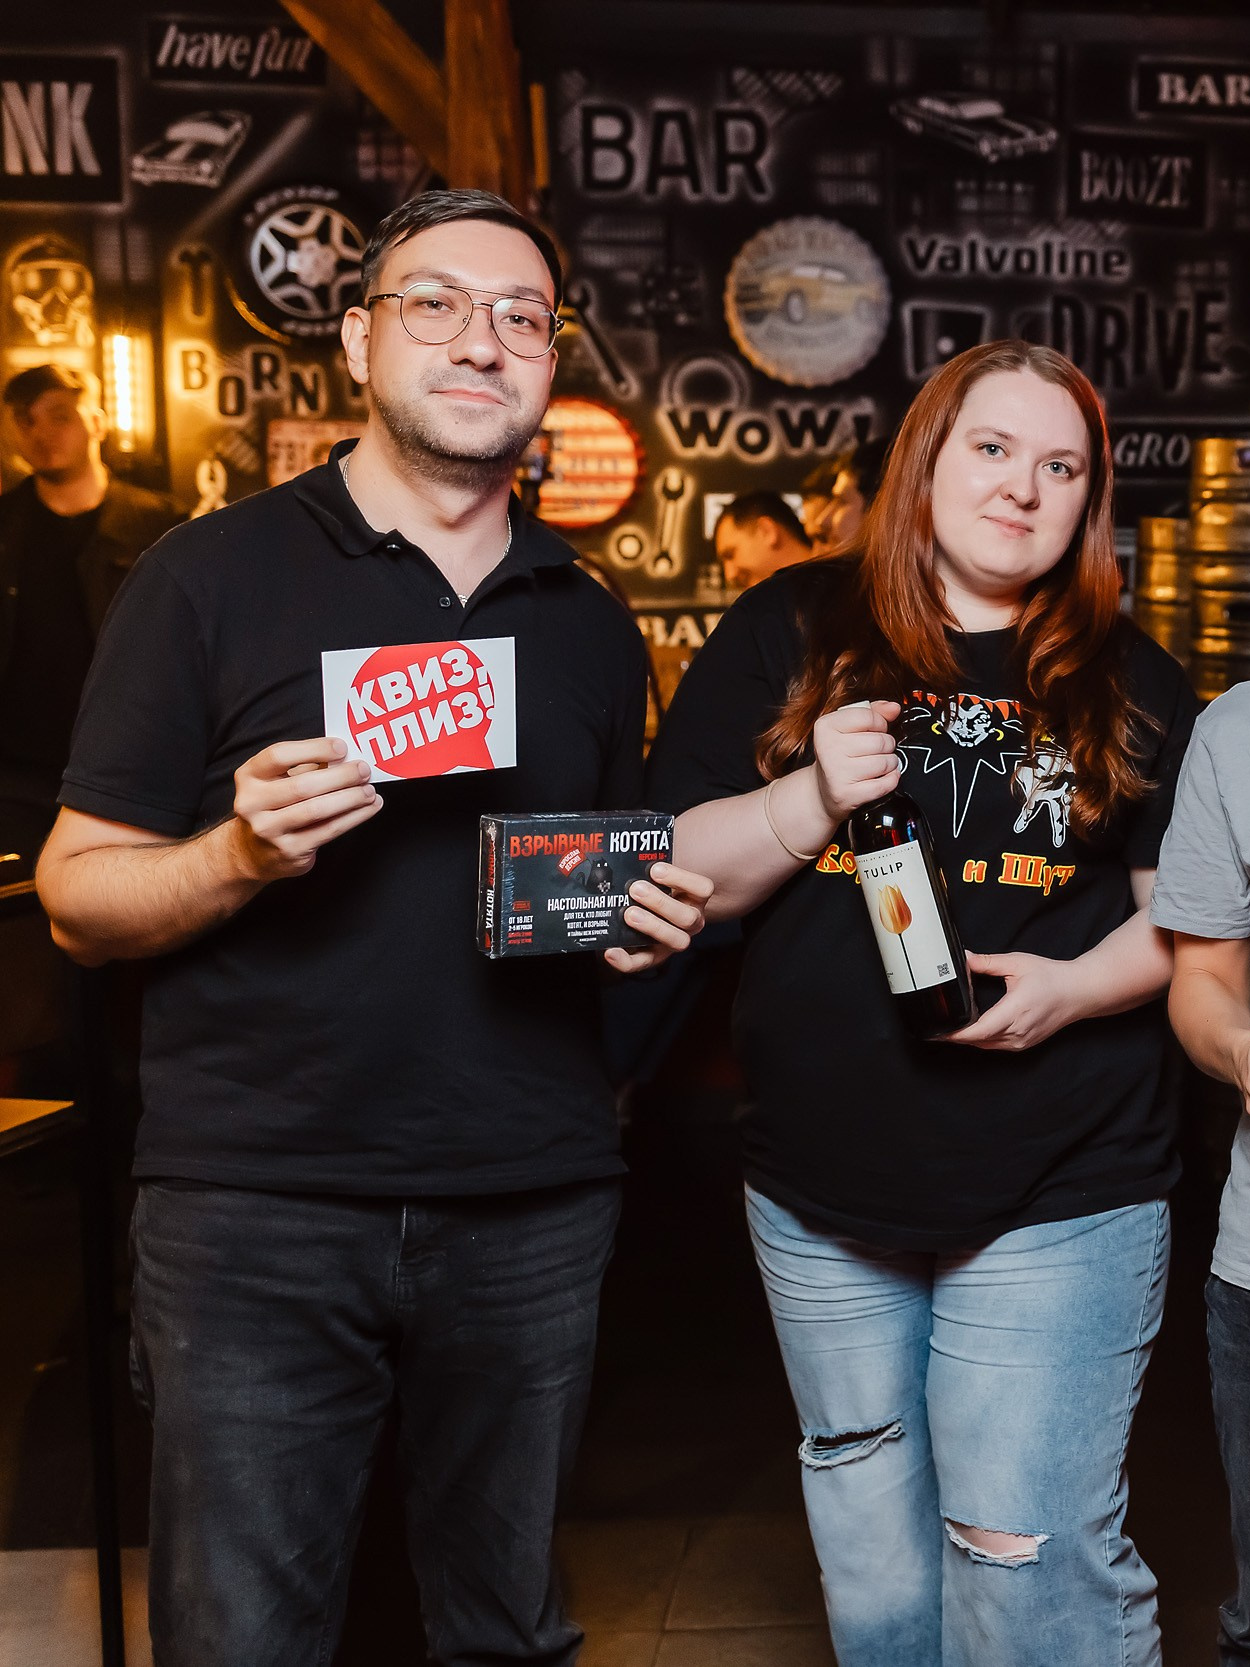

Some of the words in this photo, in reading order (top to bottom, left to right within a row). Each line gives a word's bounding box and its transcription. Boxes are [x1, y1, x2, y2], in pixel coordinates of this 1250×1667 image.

[156, 23, 250, 70] have
[581, 105, 769, 195] BAR
[1080, 150, 1192, 207] BOOZE
[905, 237, 1126, 278] Valvoline
[1051, 289, 1226, 393] DRIVE
[180, 349, 319, 417] BORN
[355, 684, 495, 766] ПЛИЗ!
[509, 833, 604, 858] ВЗРЫВНЫЕ
[609, 830, 670, 853] КОТЯТА
[863, 861, 903, 880] TULIP
[998, 852, 1076, 896] Шут
[508, 916, 516, 924] ОТ
[523, 915, 533, 923] ЛЕТ
[547, 895, 606, 911] НАСТОЛЬНАЯ
[607, 894, 630, 908] ИГРА
